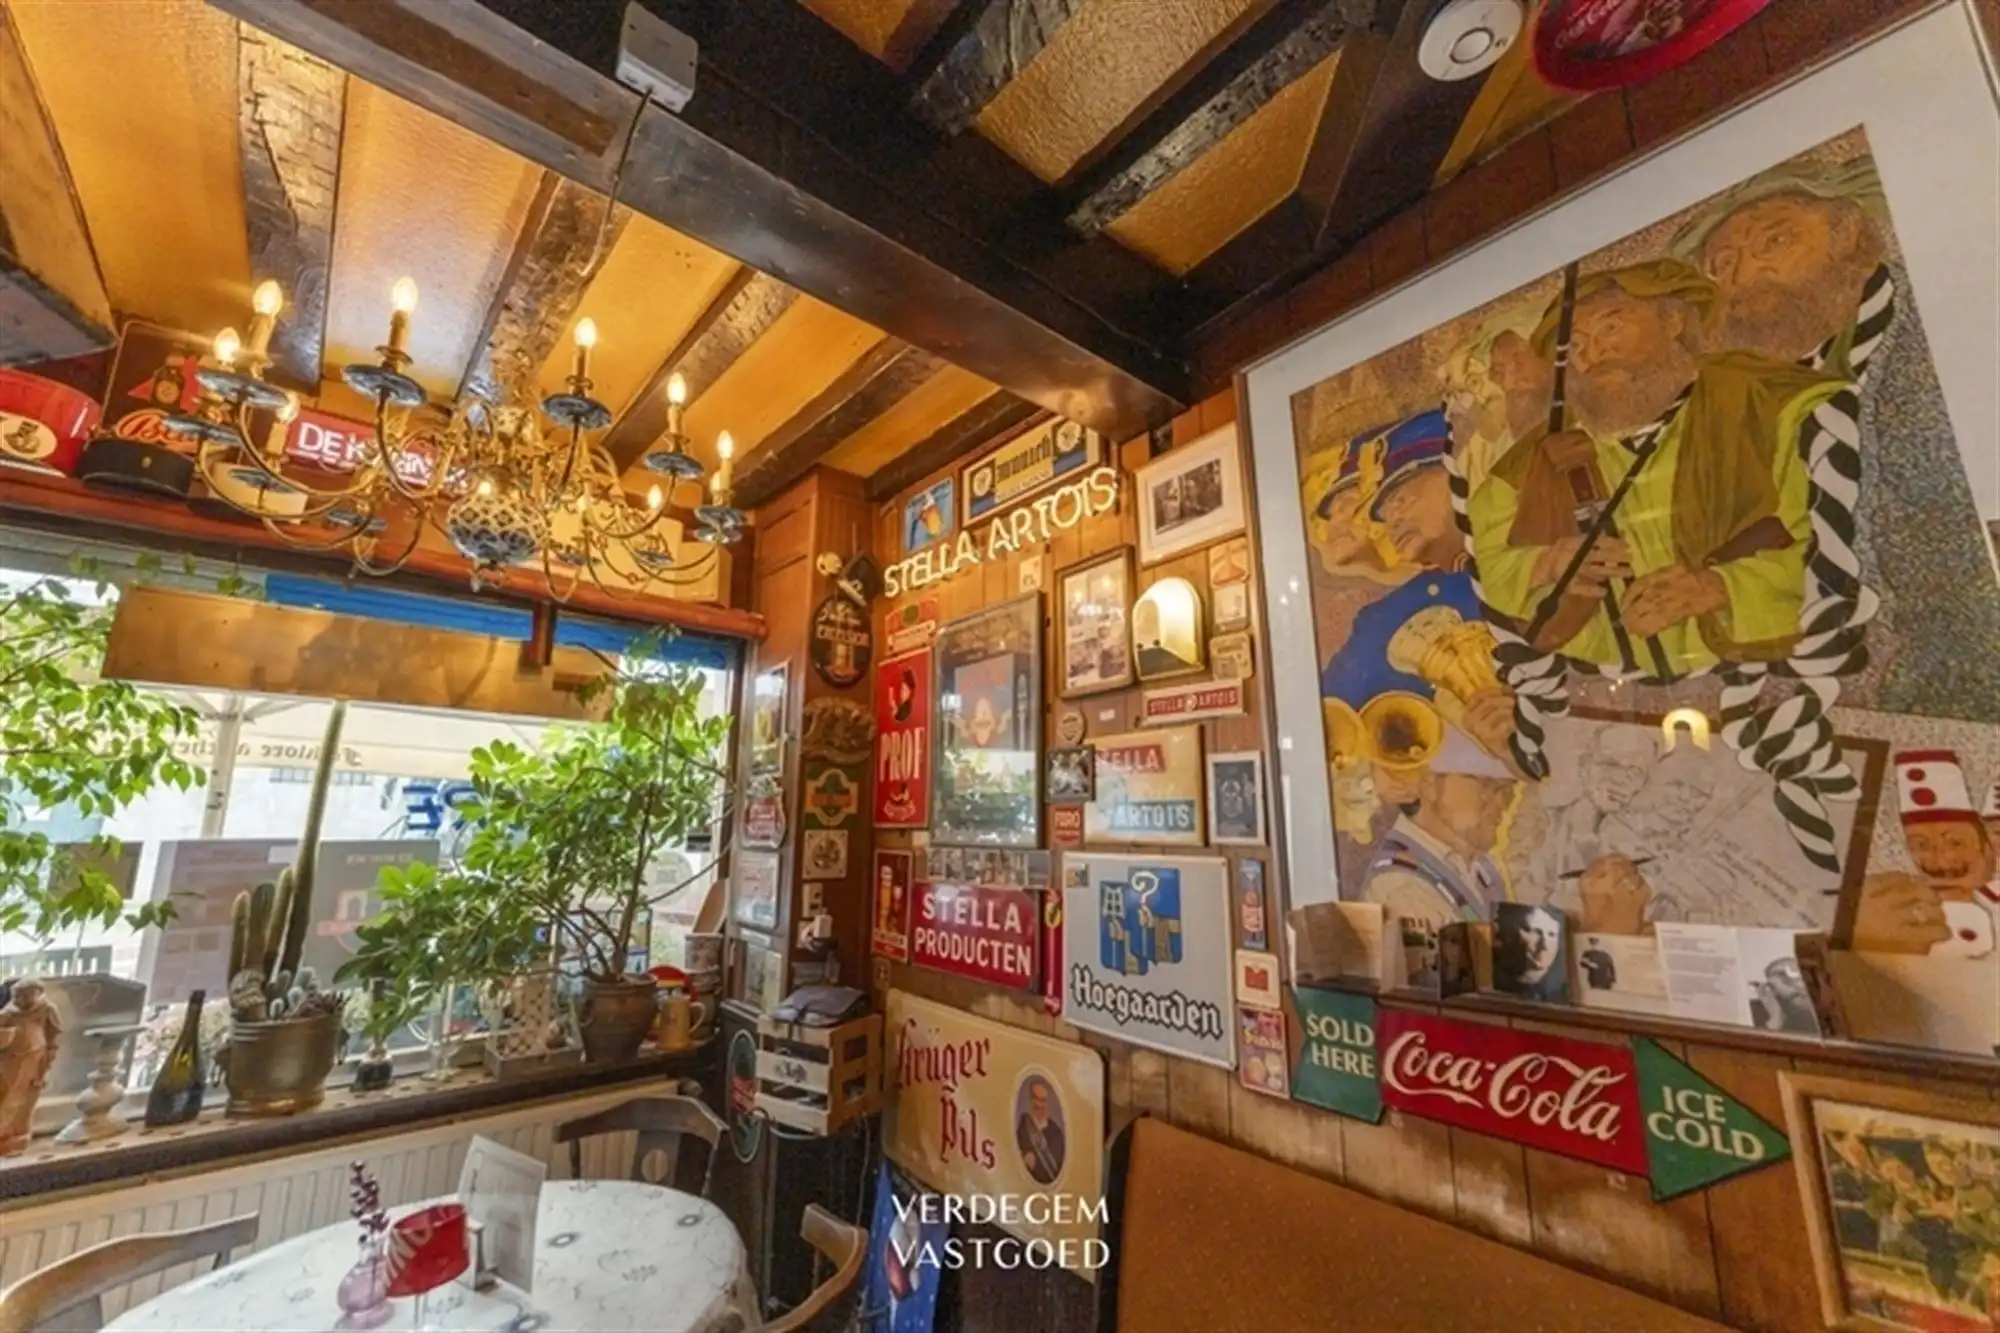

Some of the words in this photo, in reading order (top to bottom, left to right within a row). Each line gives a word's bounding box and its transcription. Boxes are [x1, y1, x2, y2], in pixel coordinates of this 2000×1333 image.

[298, 421, 343, 458] DE
[884, 530, 980, 598] STELLA
[987, 466, 1117, 560] ARTOIS
[879, 726, 926, 783] PROF
[1095, 748, 1162, 771] TELLA
[1113, 803, 1190, 828] ARTOIS
[921, 891, 1022, 934] STELLA
[914, 926, 1032, 977] PRODUCTEN
[1070, 961, 1223, 1041] Hoegaarden
[1305, 1013, 1375, 1048] SOLD
[1311, 1041, 1376, 1079] HERE
[1382, 1030, 1628, 1142] Coca-Cola
[1661, 1085, 1727, 1124] ICE
[939, 1094, 996, 1171] Pils
[1646, 1111, 1766, 1162] COLD
